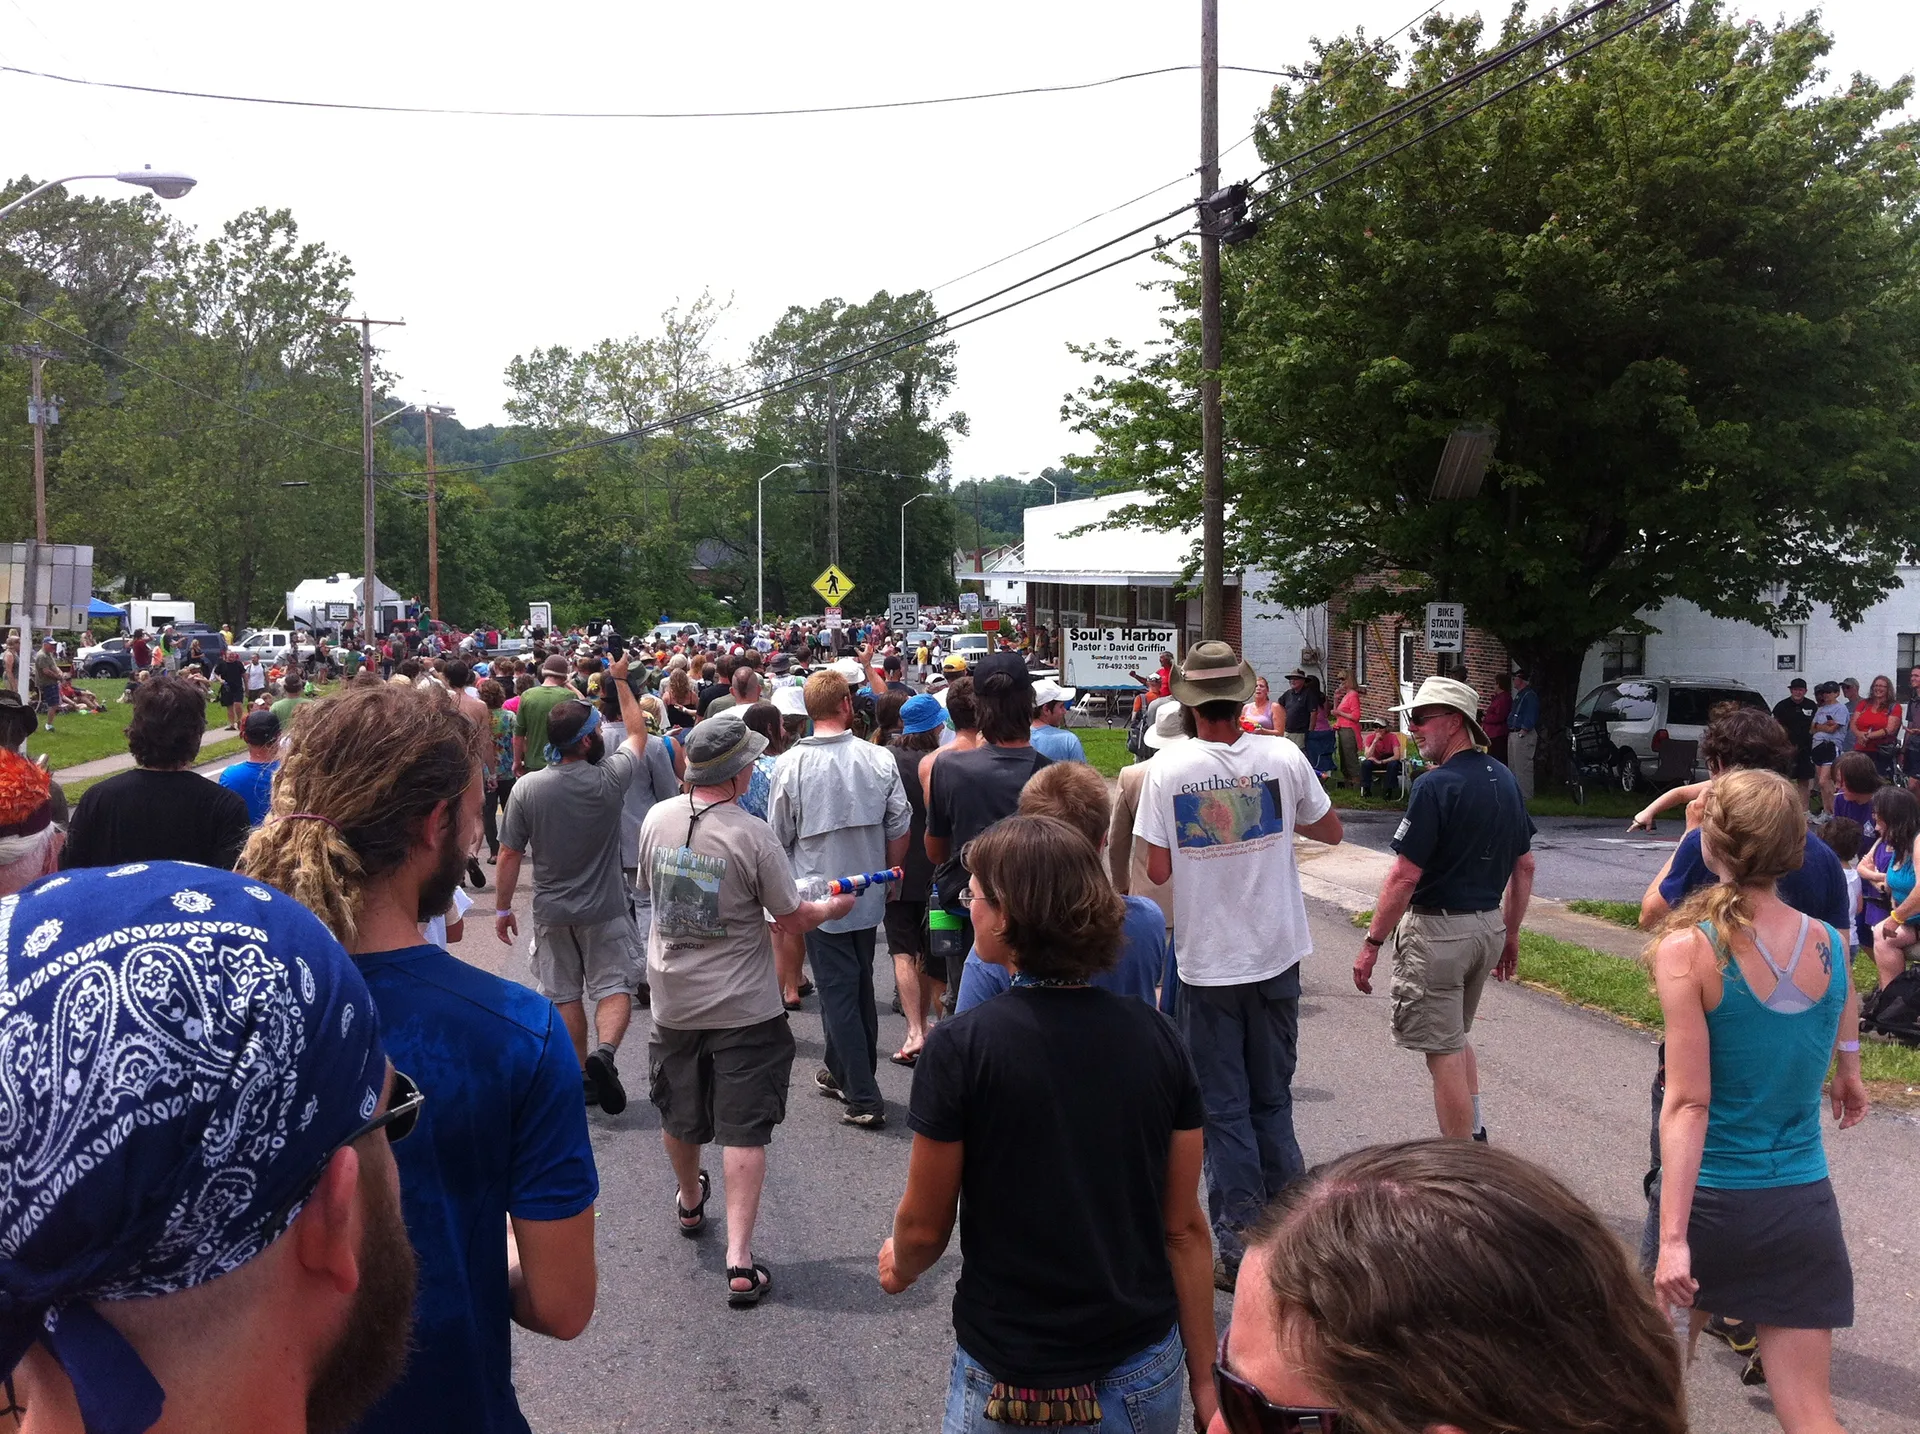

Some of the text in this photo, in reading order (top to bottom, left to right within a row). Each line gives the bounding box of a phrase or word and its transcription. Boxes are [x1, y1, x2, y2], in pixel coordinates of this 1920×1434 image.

[1437, 607, 1454, 617] BIKE
[893, 612, 916, 625] 25
[1431, 618, 1460, 628] STATION
[1070, 628, 1173, 641] Soul's Harbor
[1430, 630, 1459, 639] PARKING
[1072, 642, 1101, 651] Pastor
[1109, 643, 1135, 652] David
[1137, 643, 1166, 652] Griffin
[1181, 771, 1269, 795] earthscope
